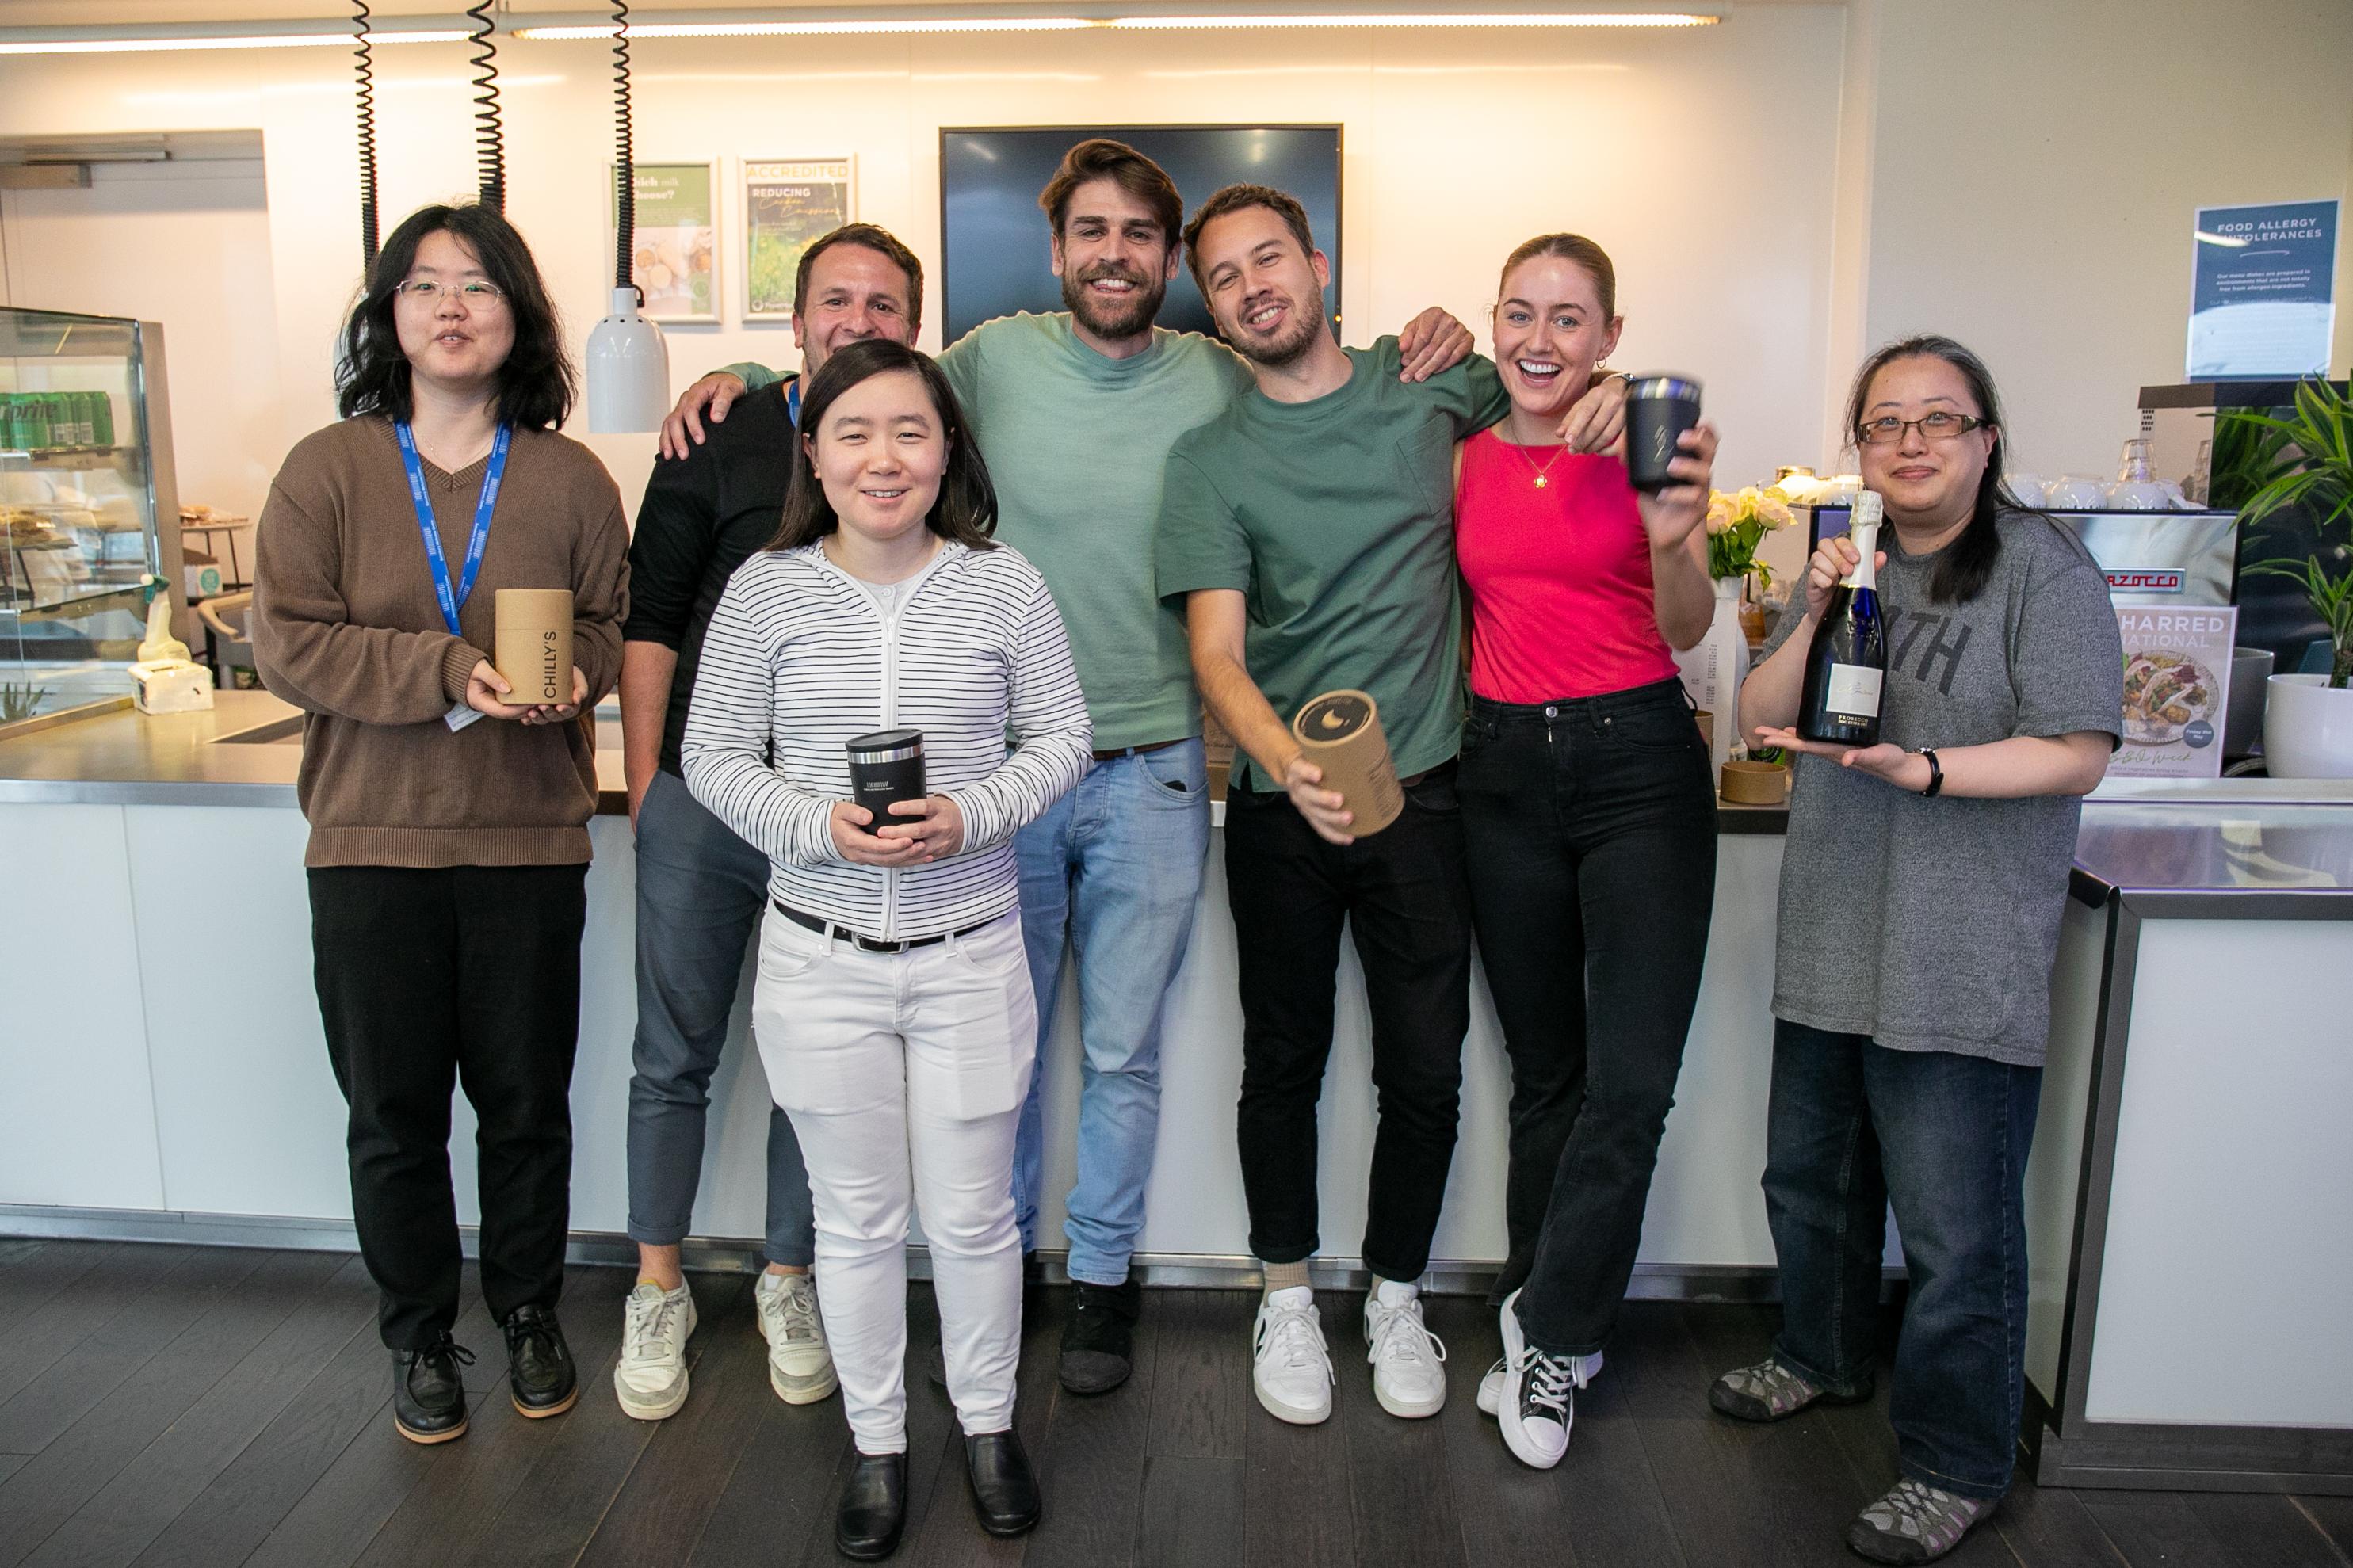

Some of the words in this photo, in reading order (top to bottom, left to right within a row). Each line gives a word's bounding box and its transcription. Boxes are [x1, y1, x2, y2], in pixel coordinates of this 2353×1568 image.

[747, 165, 848, 177] ACCREDITED
[633, 177, 658, 187] hich
[633, 190, 674, 200] hoose?
[752, 188, 811, 197] REDUCING
[2217, 222, 2253, 233] FOOD
[2258, 218, 2317, 230] ALLERGY
[2121, 615, 2225, 632] HARRED
[544, 631, 557, 699] CHILLY'S
[1838, 715, 1869, 723] PROSECCO
